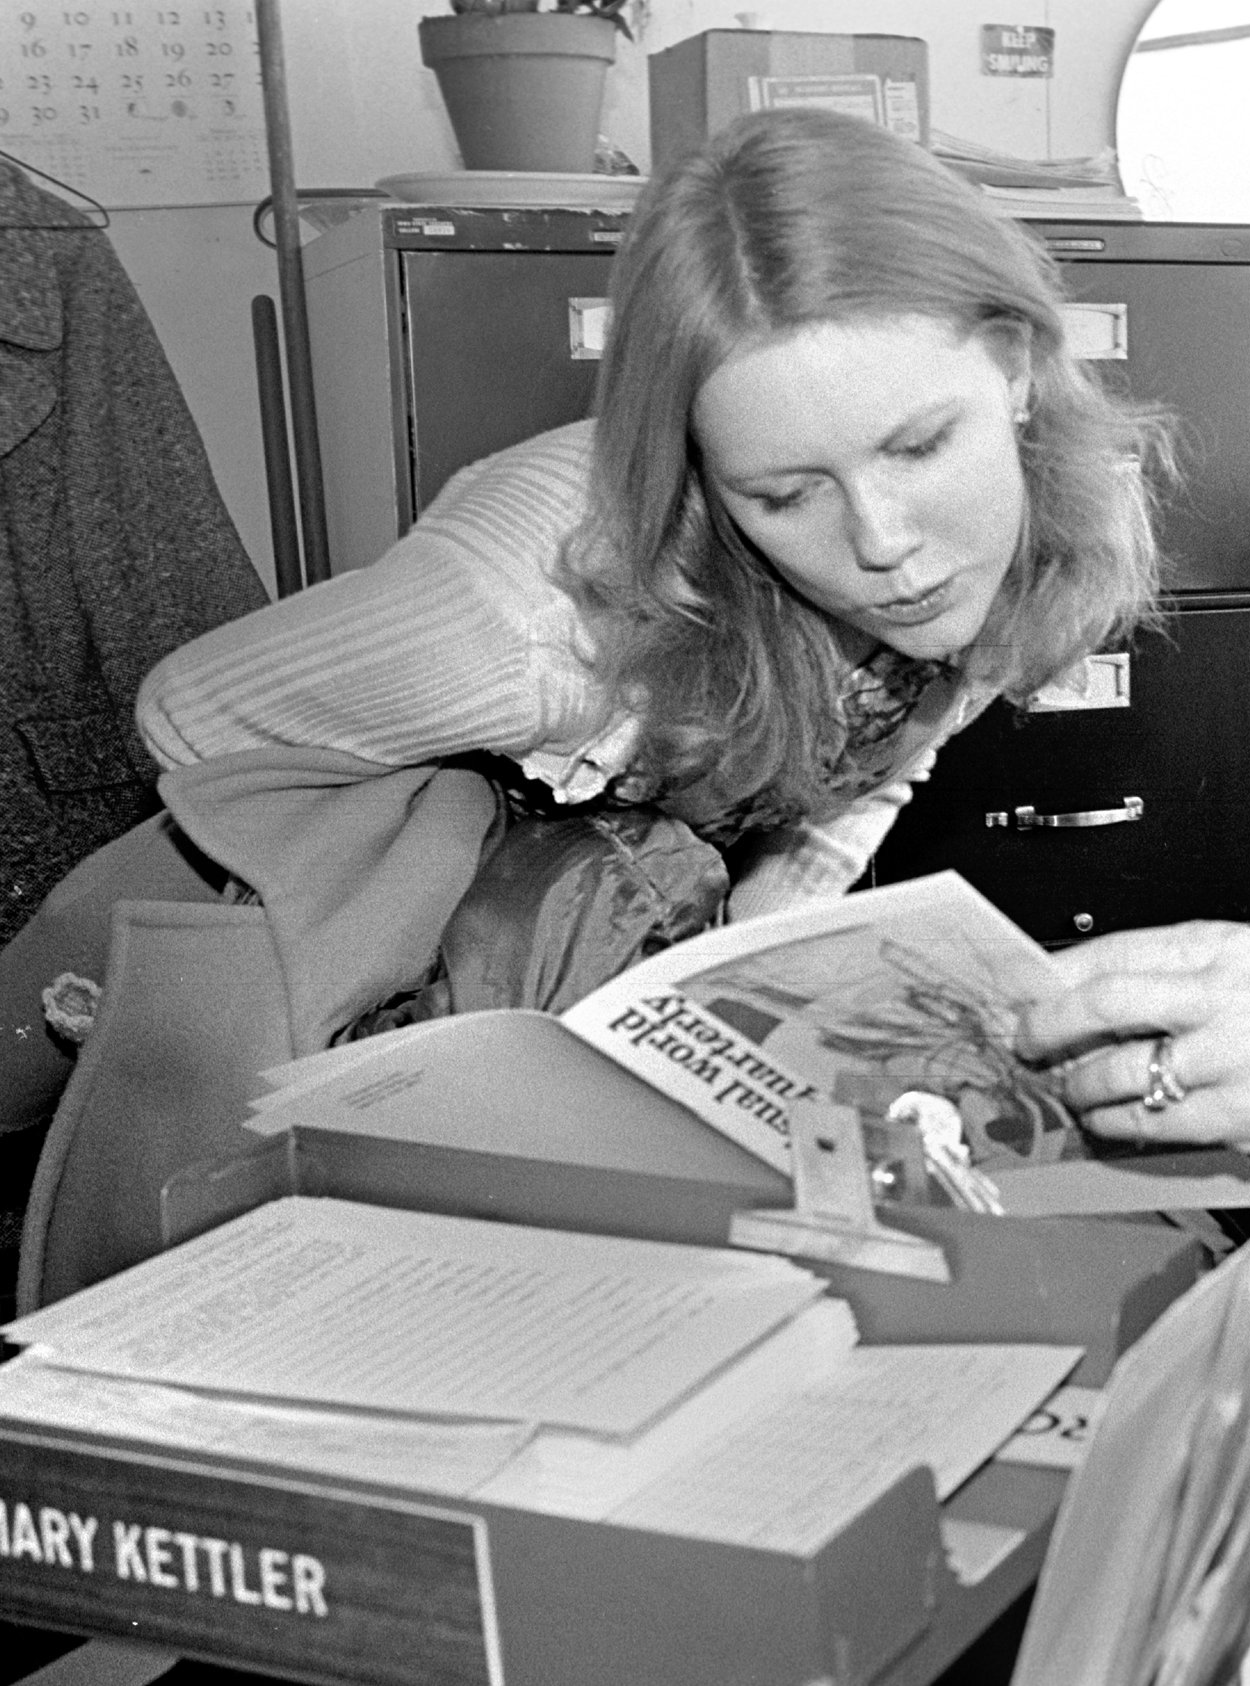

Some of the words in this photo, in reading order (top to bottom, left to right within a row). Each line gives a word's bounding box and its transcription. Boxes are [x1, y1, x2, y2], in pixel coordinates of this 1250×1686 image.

[20, 11, 36, 32] 9
[62, 11, 89, 26] 10
[111, 11, 133, 26] 11
[157, 10, 180, 26] 12
[203, 10, 226, 31] 13
[20, 39, 47, 58] 16
[68, 44, 92, 60] 17
[116, 36, 139, 57] 18
[161, 43, 185, 62] 19
[205, 42, 233, 56] 20
[28, 75, 52, 95] 23
[74, 74, 98, 95] 24
[121, 74, 144, 94] 25
[165, 68, 192, 88] 26
[209, 73, 235, 90] 27
[31, 105, 57, 127] 30
[79, 105, 100, 126] 31
[608, 1006, 723, 1084] world
[713, 1079, 792, 1149] sual
[113, 1521, 328, 1616] KETTLER
